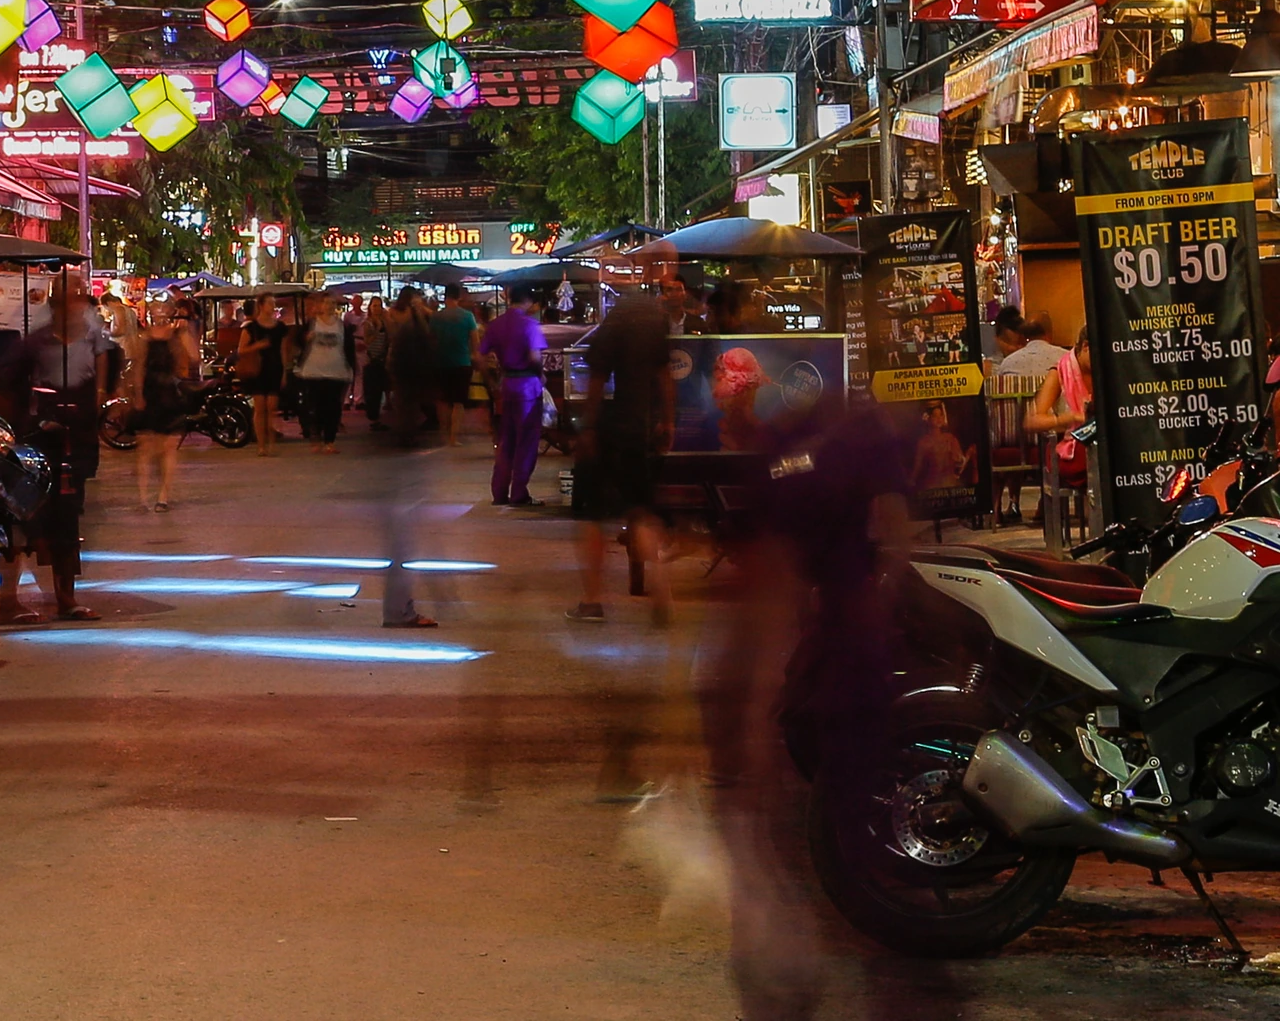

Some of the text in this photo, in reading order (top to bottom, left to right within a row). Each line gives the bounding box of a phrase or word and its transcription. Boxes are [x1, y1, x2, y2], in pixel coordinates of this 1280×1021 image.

[1128, 139, 1206, 171] TEMPLE
[1151, 168, 1185, 180] CLUB
[1115, 191, 1215, 209] FROM OPEN TO 9PM
[888, 223, 938, 245] TEMPLE
[1098, 216, 1238, 250] DRAFT BEER
[323, 250, 352, 263] HUY
[403, 249, 437, 262] MINI
[438, 248, 481, 261] MART
[1113, 242, 1228, 295] $0.50
[1146, 302, 1196, 319] MEKONG
[1128, 312, 1216, 332] WHISKEY COKE
[1112, 328, 1203, 353] GLASS $1.75
[1153, 338, 1253, 365] BUCKET $5.00
[893, 366, 960, 380] APSARA BALCONY
[887, 377, 967, 392] DRAFT BEER $0.50
[1128, 376, 1228, 395] VODKA RED BULL
[1118, 393, 1209, 419] GLASS $2.00
[1158, 415, 1202, 430] BUCKET
[1140, 449, 1167, 464] RUM
[1170, 447, 1195, 461] AND
[1115, 462, 1206, 487] GLASS $200
